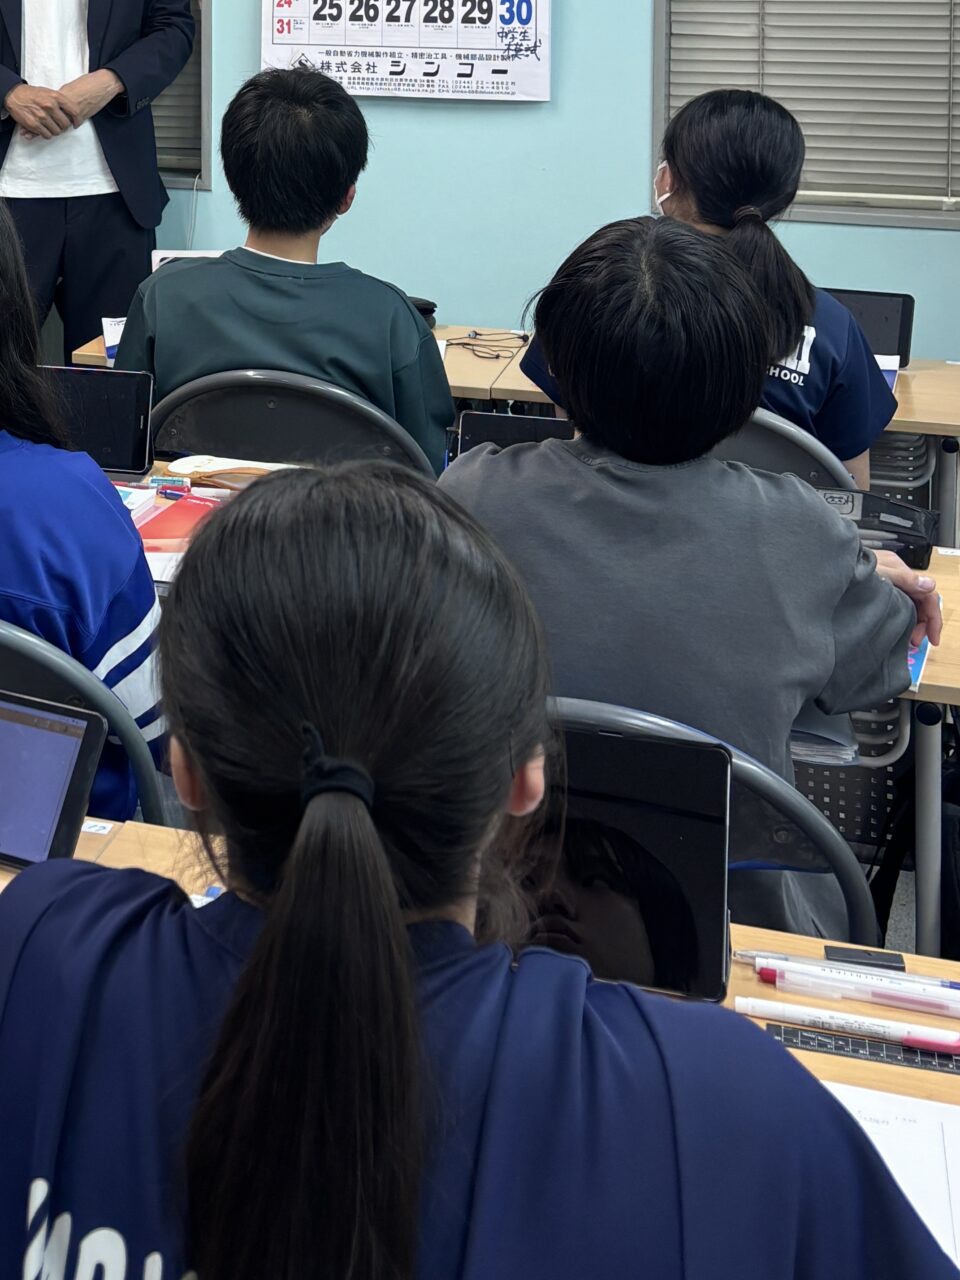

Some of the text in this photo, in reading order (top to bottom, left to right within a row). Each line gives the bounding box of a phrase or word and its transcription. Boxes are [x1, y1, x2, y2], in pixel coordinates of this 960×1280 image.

[276, 19, 291, 34] 31
[320, 60, 508, 78] 株式会社 シンコー
[766, 367, 805, 386] HOOL
